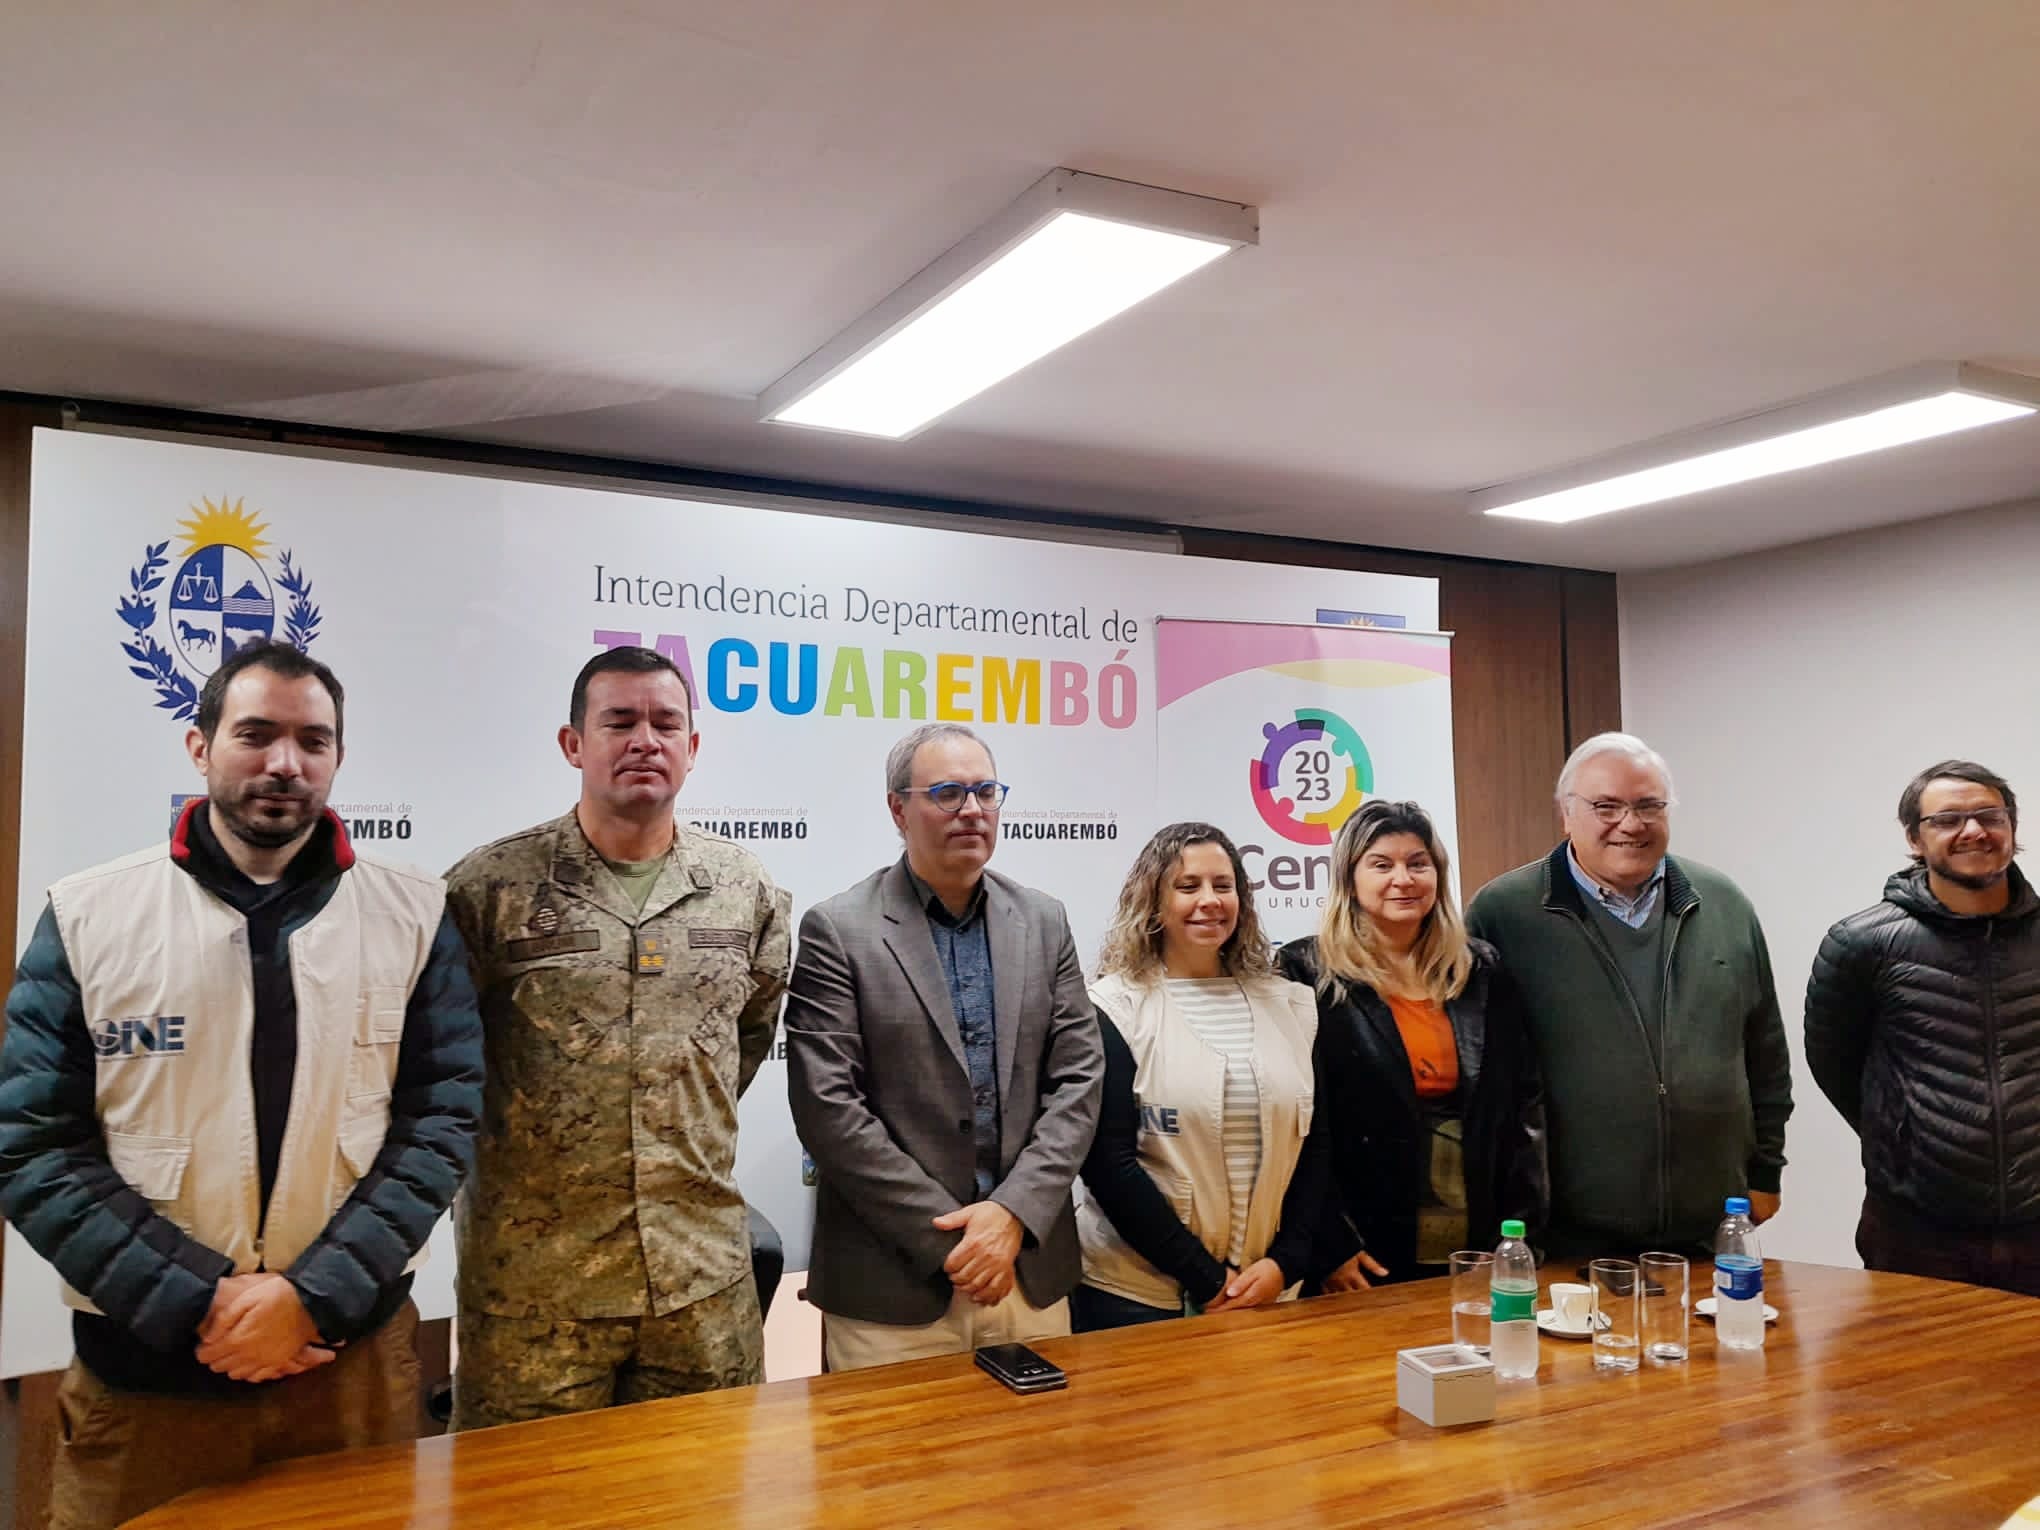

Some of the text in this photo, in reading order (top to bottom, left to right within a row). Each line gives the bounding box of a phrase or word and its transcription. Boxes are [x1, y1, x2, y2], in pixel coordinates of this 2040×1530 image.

[593, 564, 1138, 643] Intendencia Departamental de
[1295, 751, 1330, 775] 20
[1296, 777, 1331, 801] 23
[1002, 820, 1118, 840] TACUAREMBÓ
[1237, 844, 1331, 891] Cen
[1268, 896, 1325, 909] URUG
